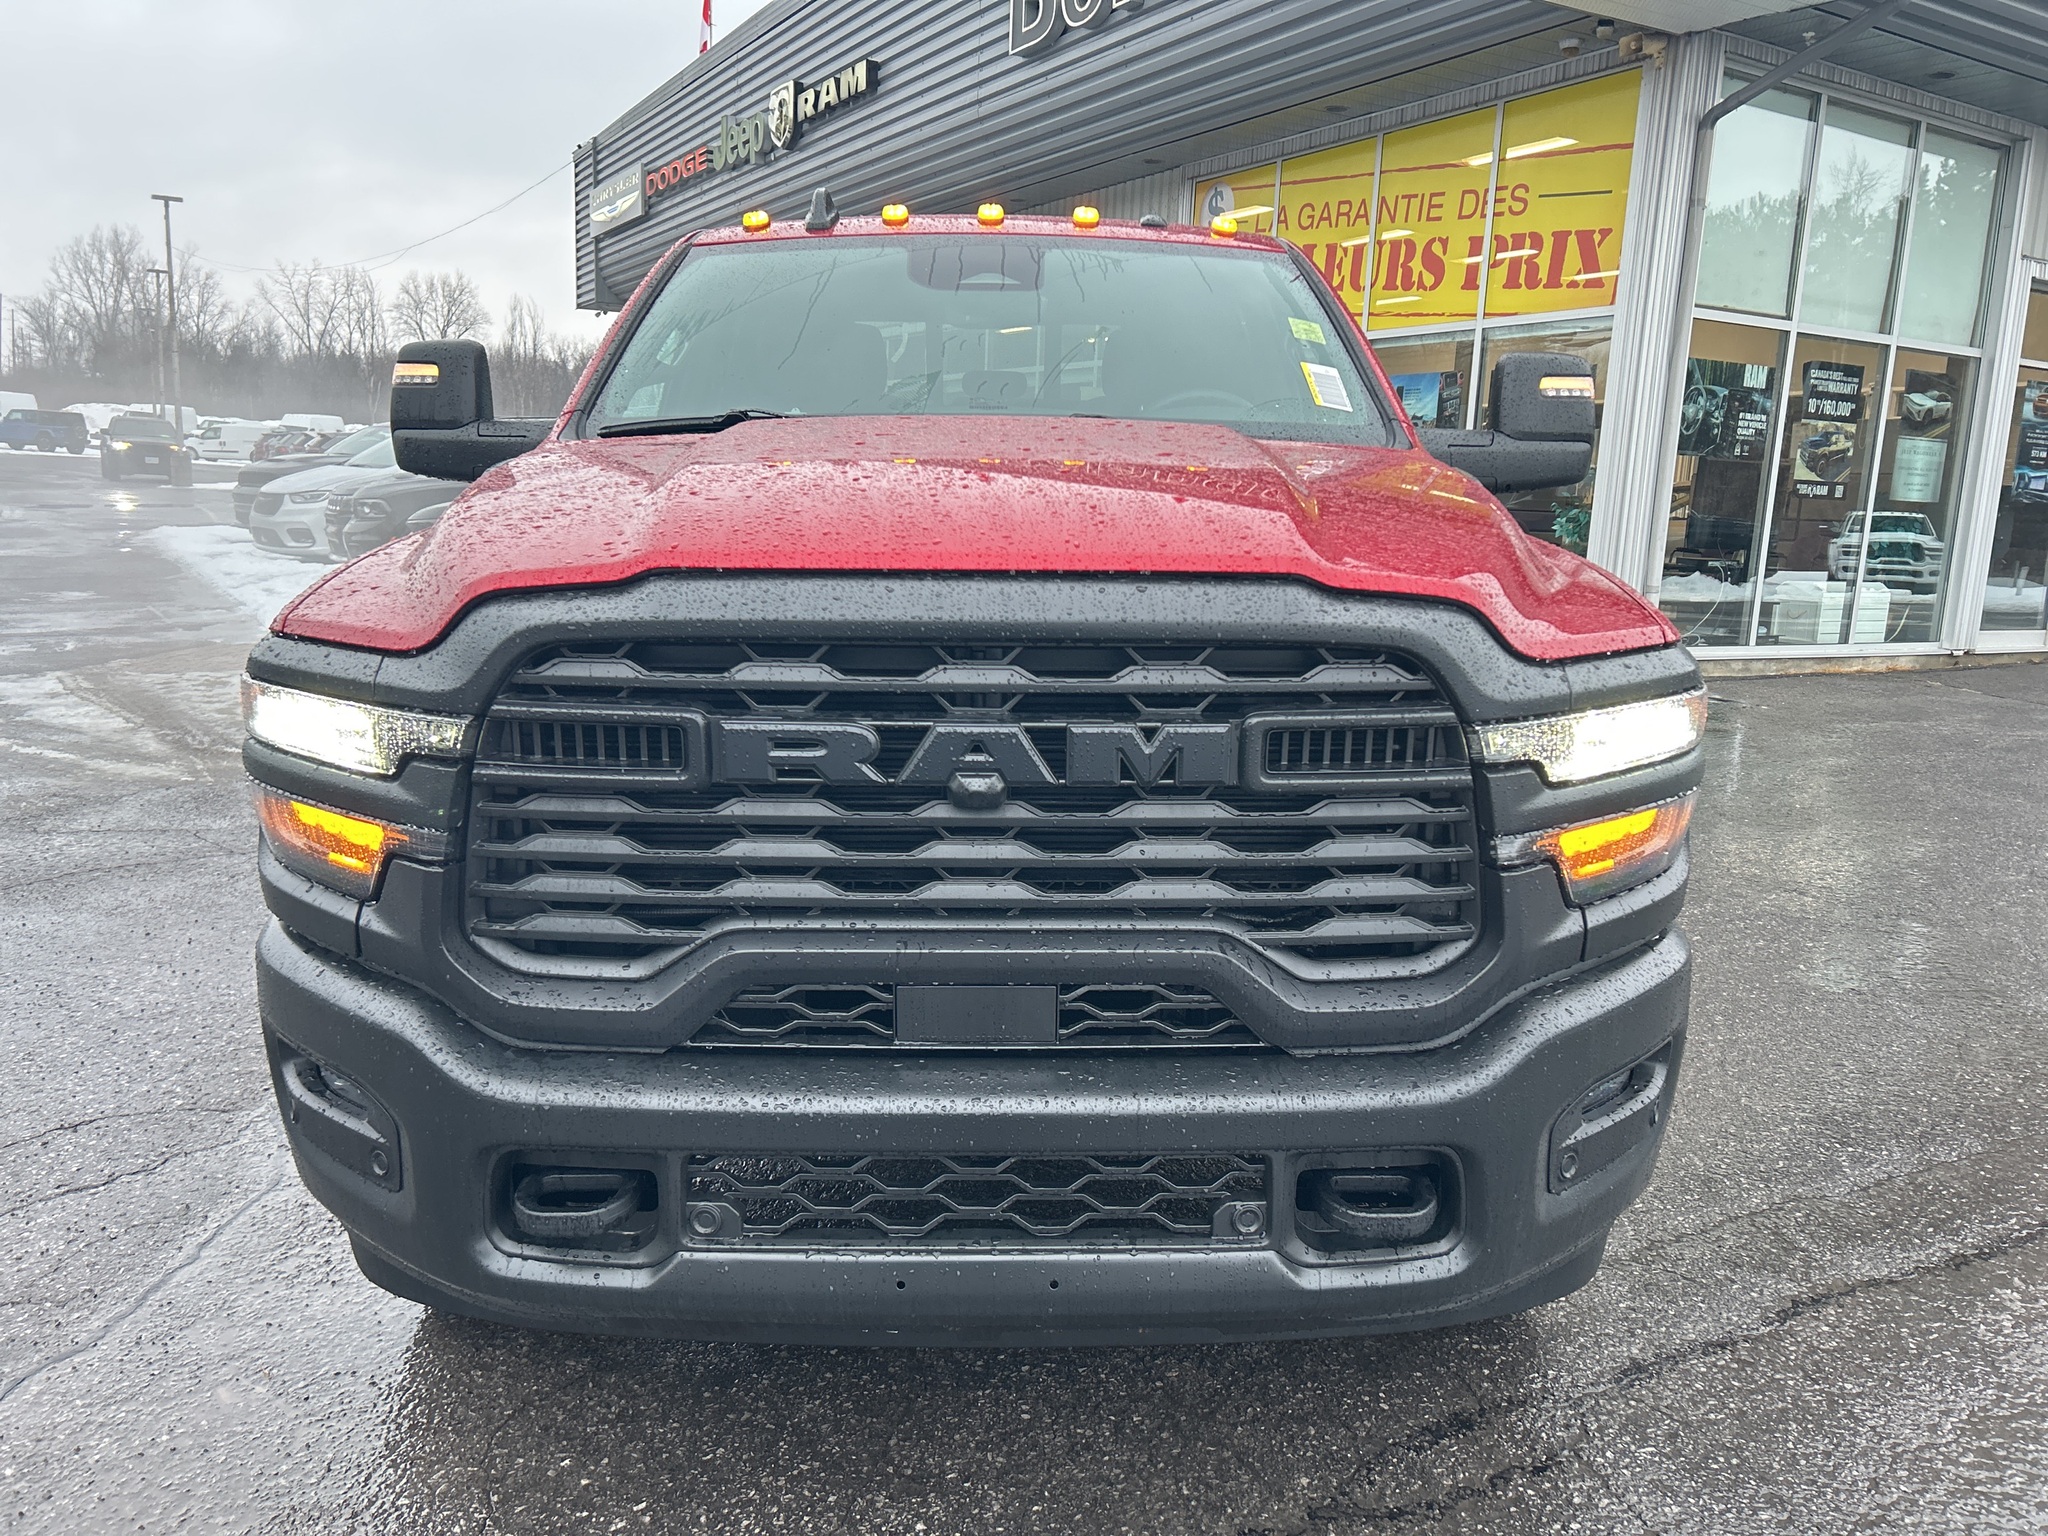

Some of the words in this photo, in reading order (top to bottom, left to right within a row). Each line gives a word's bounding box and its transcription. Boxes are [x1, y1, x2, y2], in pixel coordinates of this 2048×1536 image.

[797, 59, 868, 122] RAM
[712, 111, 765, 171] Jeep
[645, 145, 708, 197] DODGE
[1255, 204, 1289, 233] LA
[1297, 191, 1446, 231] GARANTIE
[1457, 183, 1530, 220] DES
[1460, 228, 1613, 291] PRIX
[1743, 364, 1768, 389] RAM
[1810, 369, 1833, 380] CANADA'S
[1828, 381, 1859, 395] WARRANTY
[1745, 412, 1761, 421] BRAND
[1748, 421, 1767, 429] VEHICLE
[1736, 427, 1756, 435] QUALITY
[1816, 484, 1829, 495] RAM
[719, 720, 1232, 786] RAM
